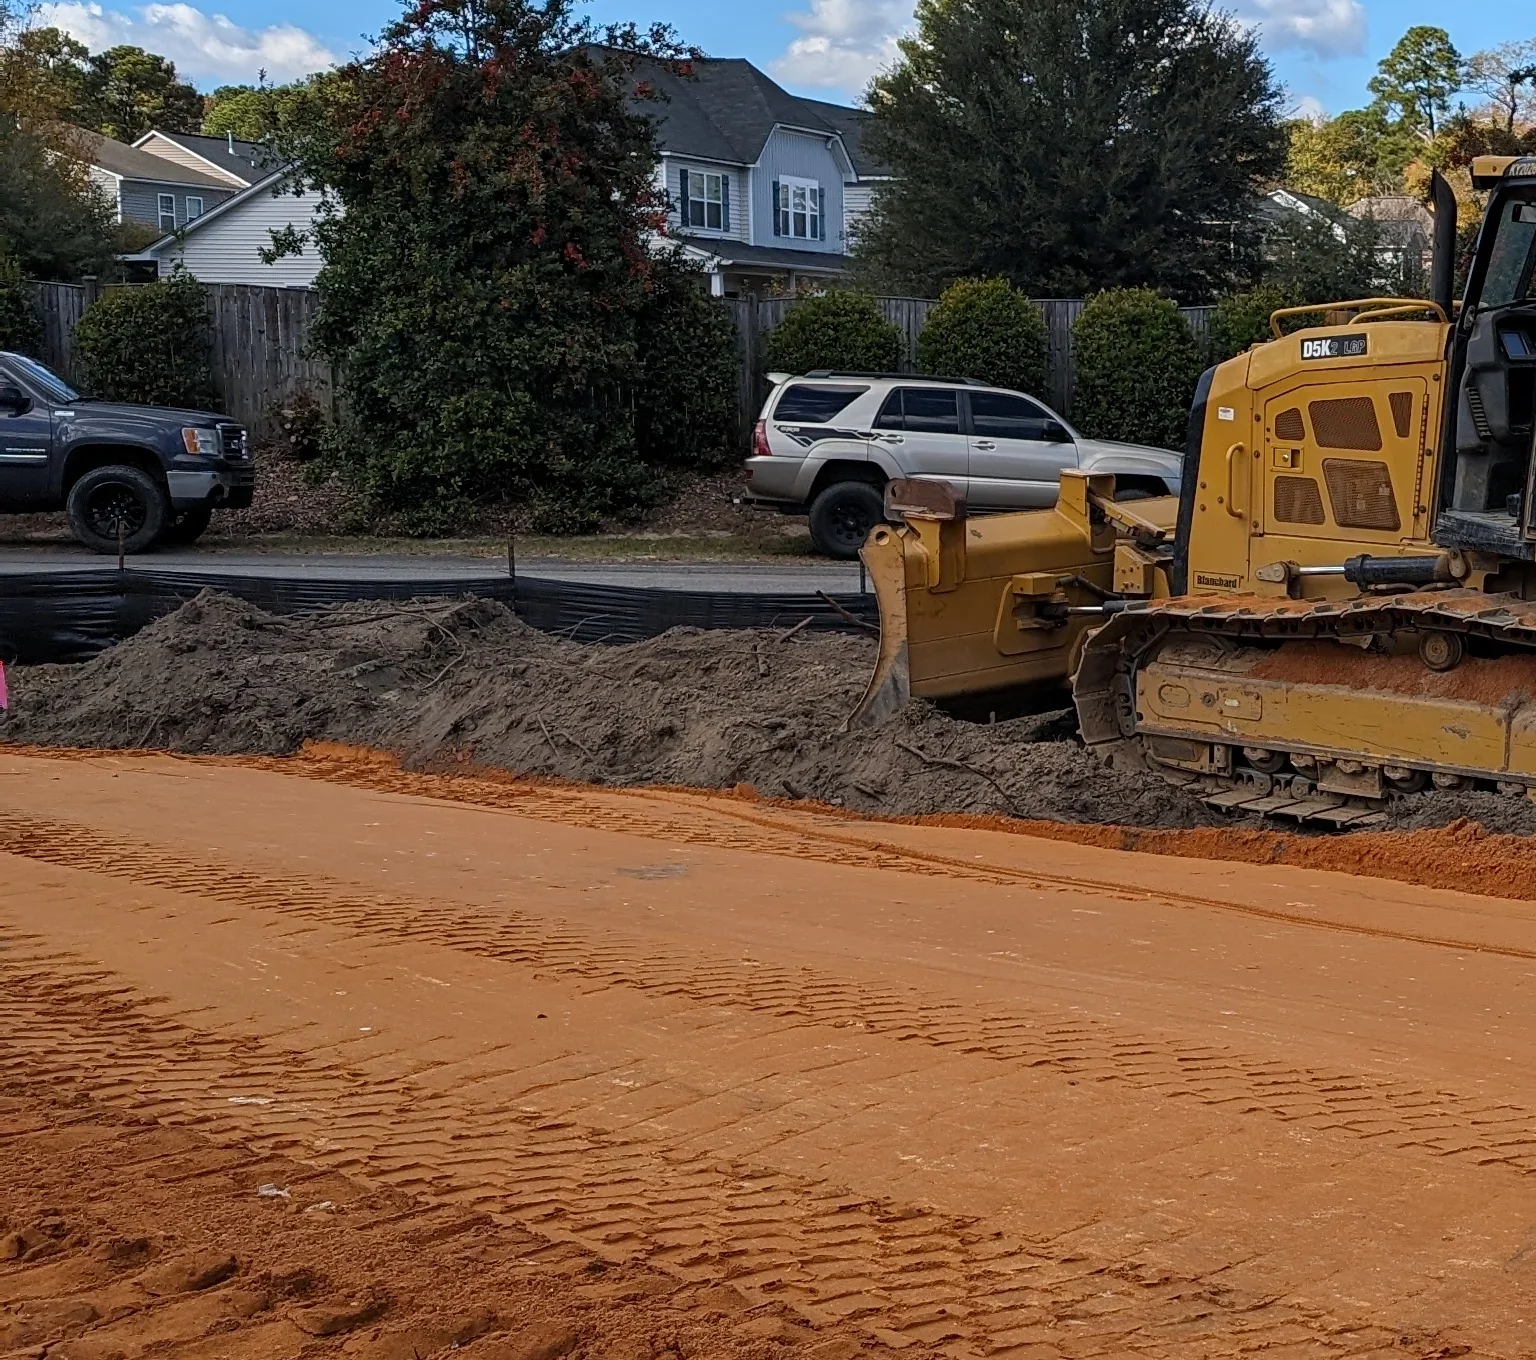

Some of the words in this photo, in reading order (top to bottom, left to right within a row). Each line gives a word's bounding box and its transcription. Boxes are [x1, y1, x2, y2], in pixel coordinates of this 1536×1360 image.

[1303, 339, 1338, 358] D5K2
[1343, 339, 1366, 355] LGP
[1196, 575, 1238, 589] Blanchard
